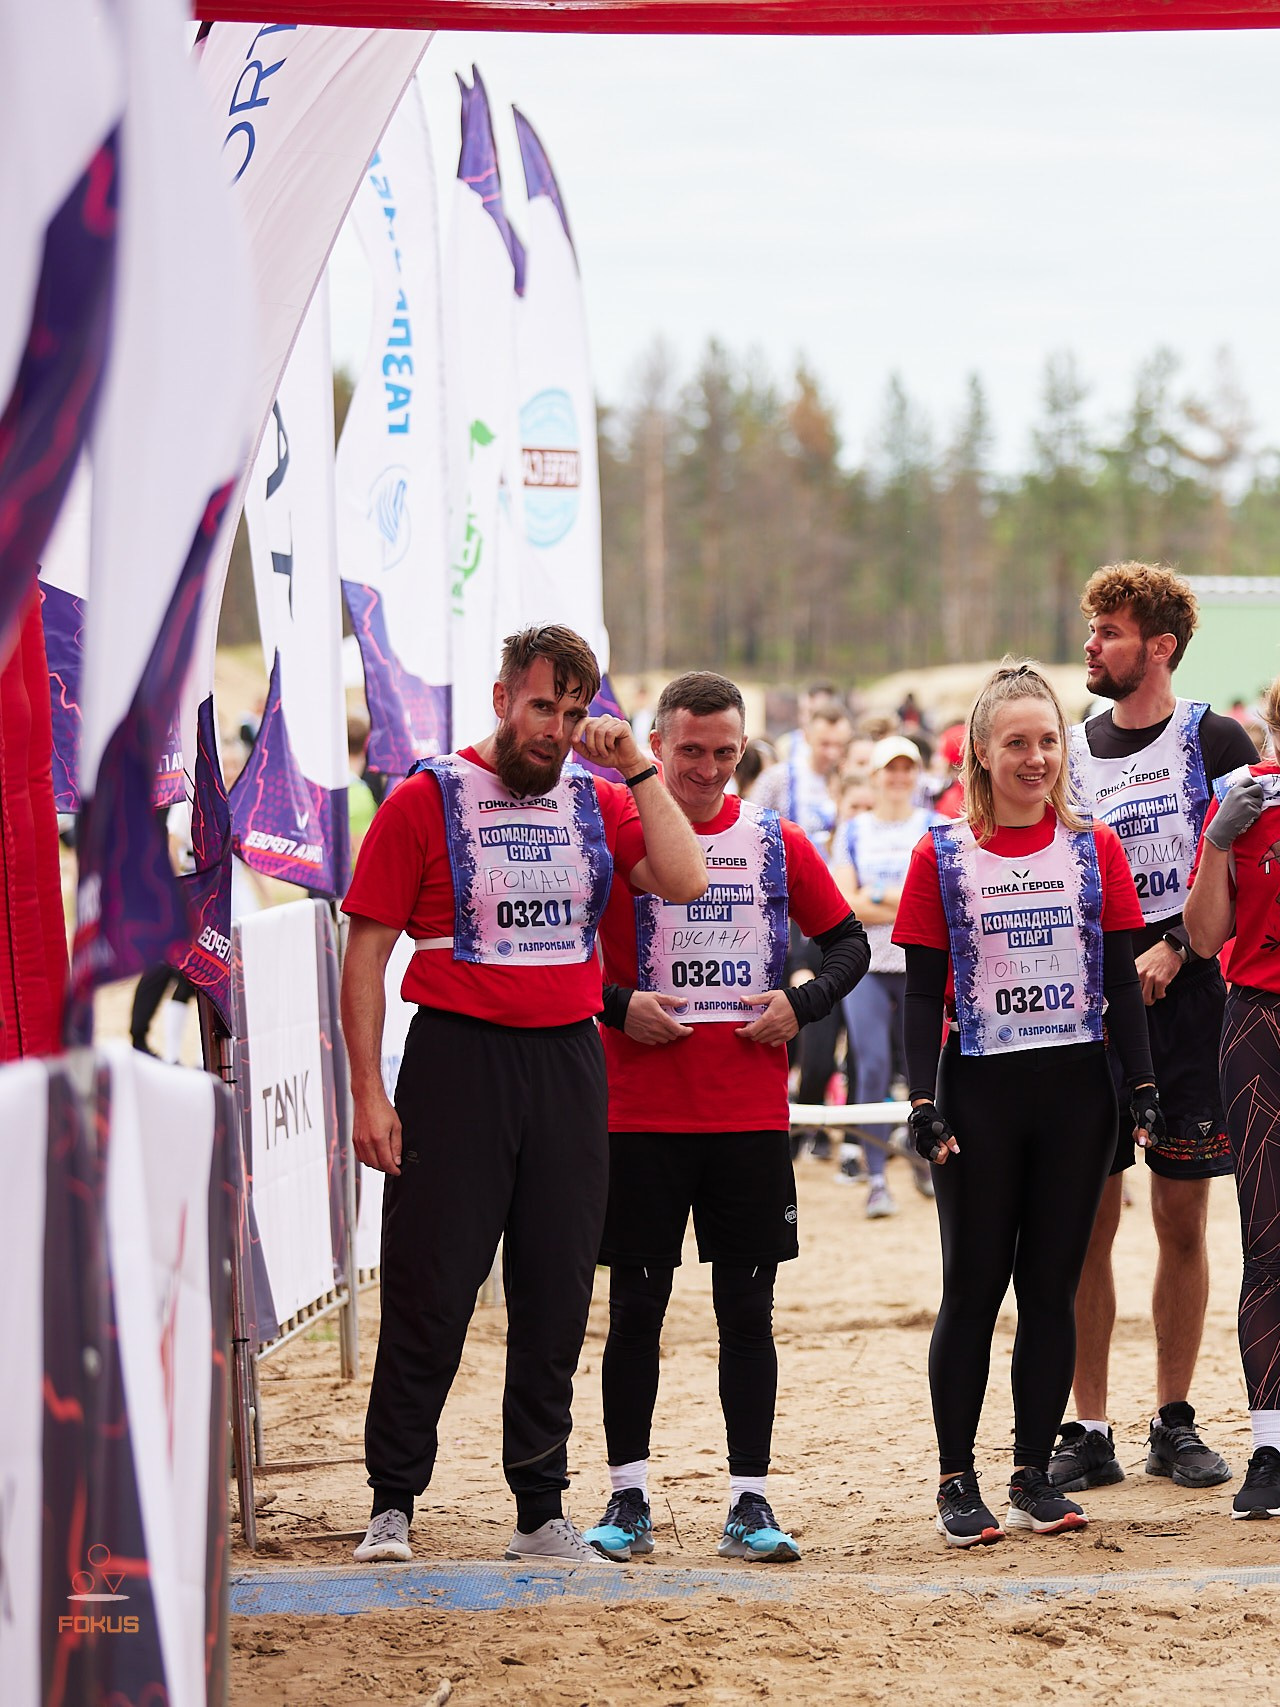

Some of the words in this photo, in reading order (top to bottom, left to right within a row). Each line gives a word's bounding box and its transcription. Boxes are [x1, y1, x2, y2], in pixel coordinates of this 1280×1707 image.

[1129, 768, 1170, 784] ГЕРОЕВ
[478, 800, 516, 811] ГОНКА
[519, 797, 558, 810] ГЕРОЕВ
[481, 826, 569, 845] КОМАНДНЫЙ
[1119, 818, 1156, 837] СТАРТ
[509, 845, 548, 861] СТАРТ
[705, 857, 748, 867] ГЕРОЕВ
[487, 869, 572, 893] РОМАН
[981, 883, 1020, 896] ГОНКА
[1022, 880, 1065, 892] ГЕРОЕВ
[1134, 868, 1180, 899] 204
[678, 885, 753, 904] НДНЫЙ
[497, 900, 573, 928] 03201
[689, 904, 730, 920] СТАРТ
[983, 906, 1072, 931] КОМАНДНЫЙ
[518, 940, 576, 952] ГАЗПРОМБАНК
[1010, 929, 1050, 947] СТАРТ
[672, 960, 751, 988] 03203
[995, 983, 1075, 1016] 03202
[1018, 1023, 1077, 1037] ГАЗПРОМБАНК
